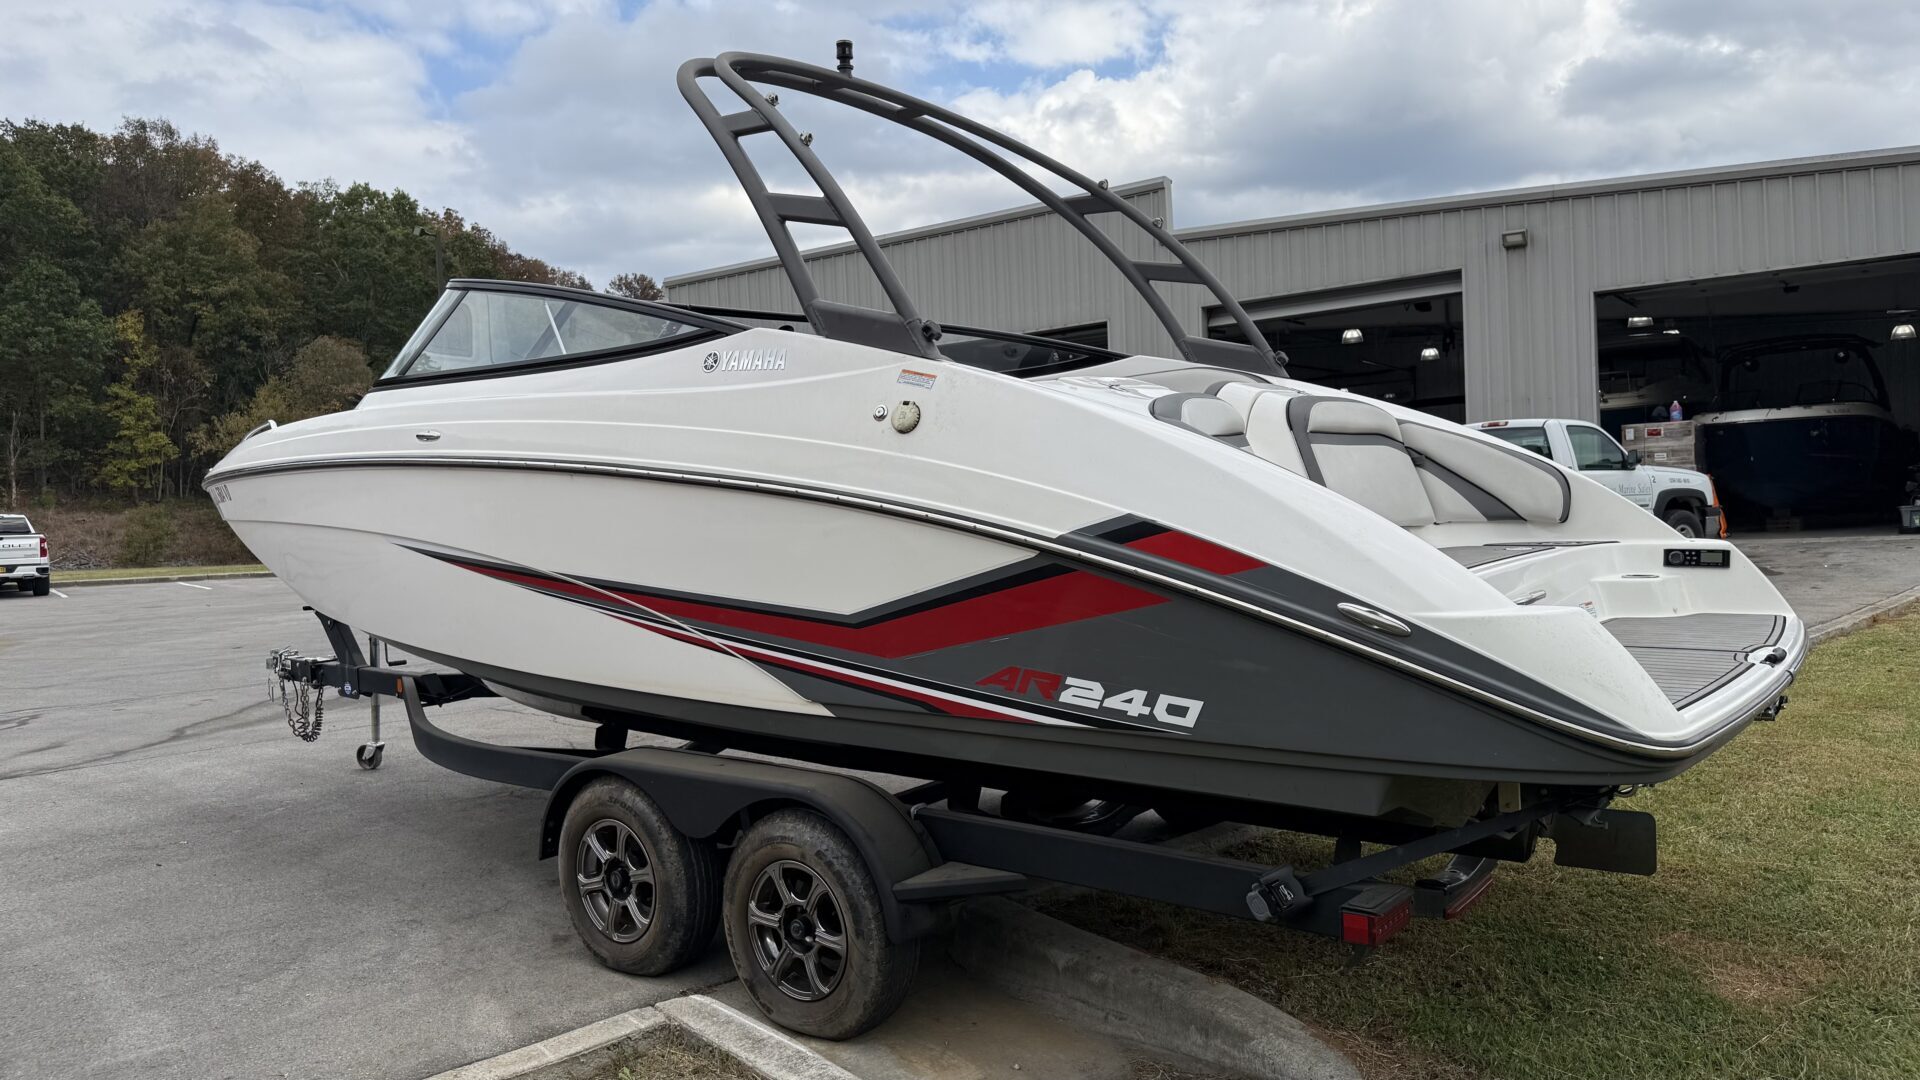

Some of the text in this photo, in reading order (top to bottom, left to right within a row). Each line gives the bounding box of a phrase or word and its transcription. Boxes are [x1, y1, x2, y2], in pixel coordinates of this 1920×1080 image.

[721, 348, 788, 372] YAMAHA
[1651, 475, 1657, 484] 2
[975, 665, 1205, 729] AR240
